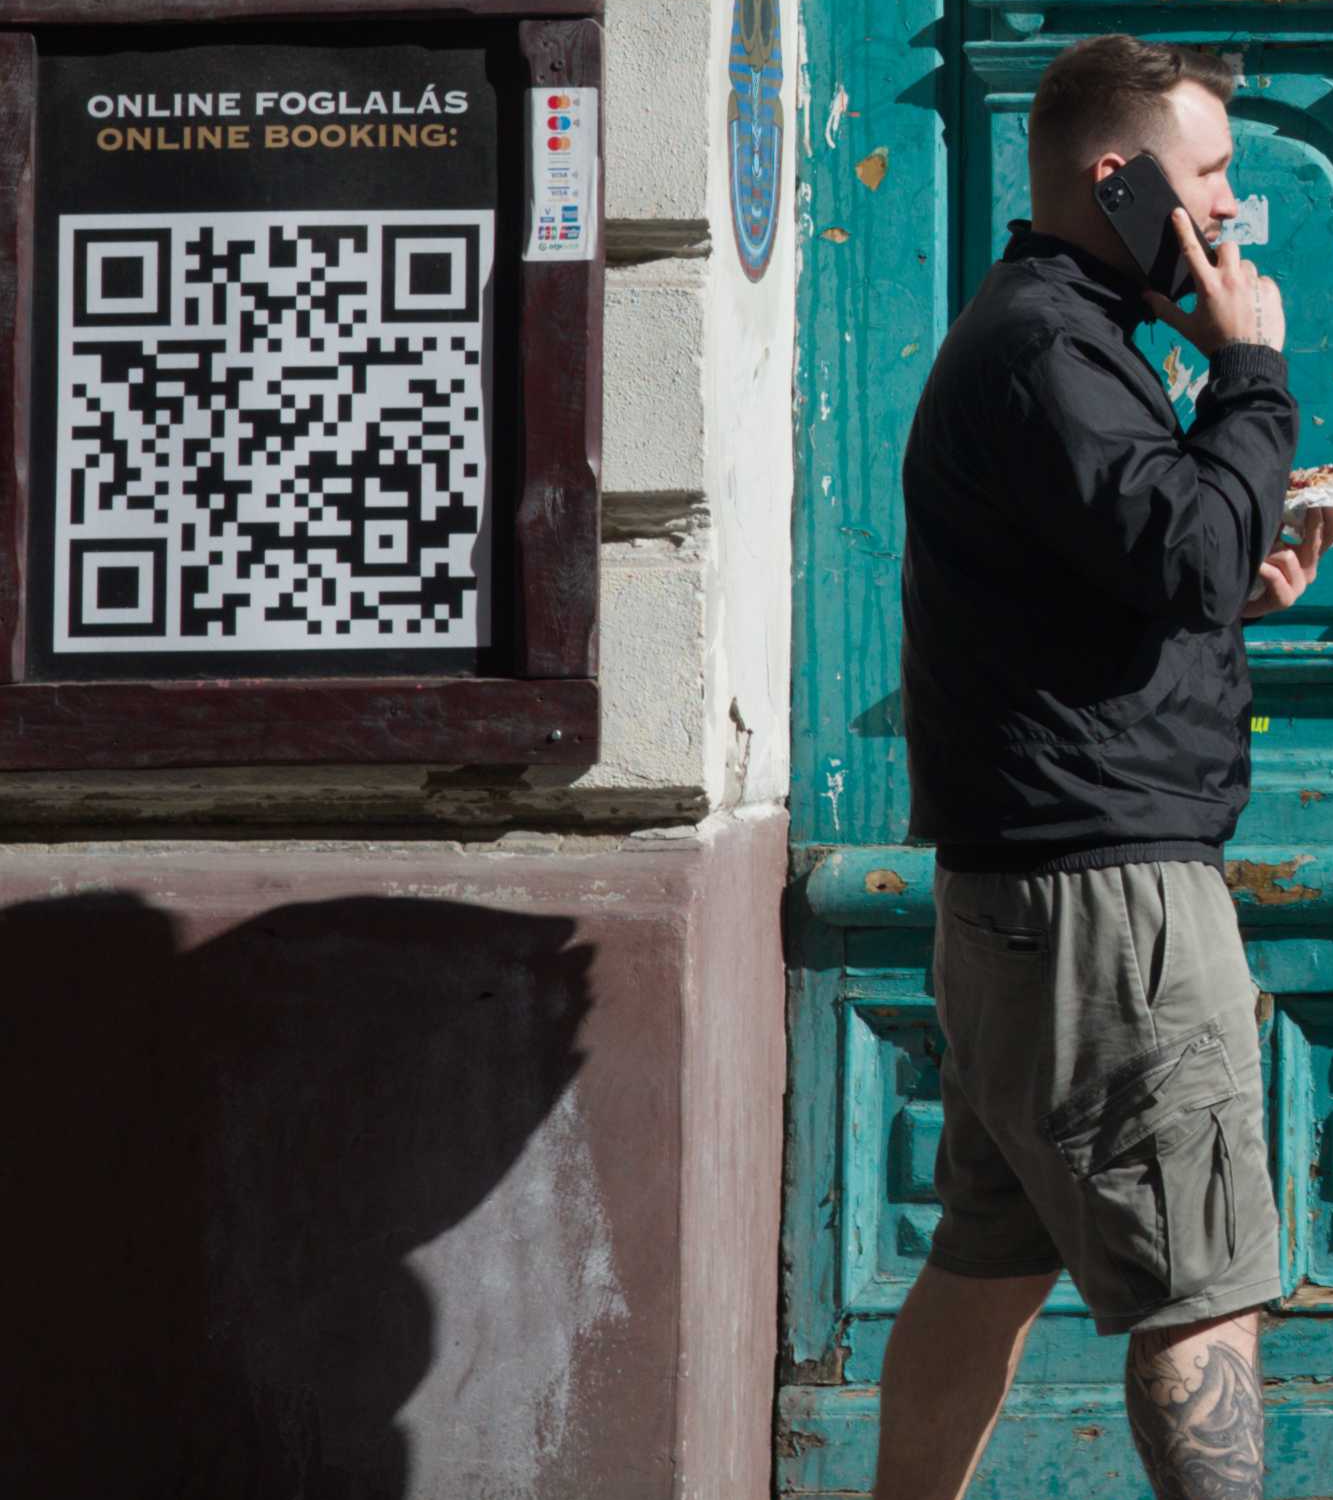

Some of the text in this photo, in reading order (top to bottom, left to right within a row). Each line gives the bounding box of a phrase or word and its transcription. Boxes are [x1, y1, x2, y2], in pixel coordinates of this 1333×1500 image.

[87, 84, 469, 118] ONLINE FOGLALÁS
[96, 123, 458, 151] ONLINE BOOKING:
